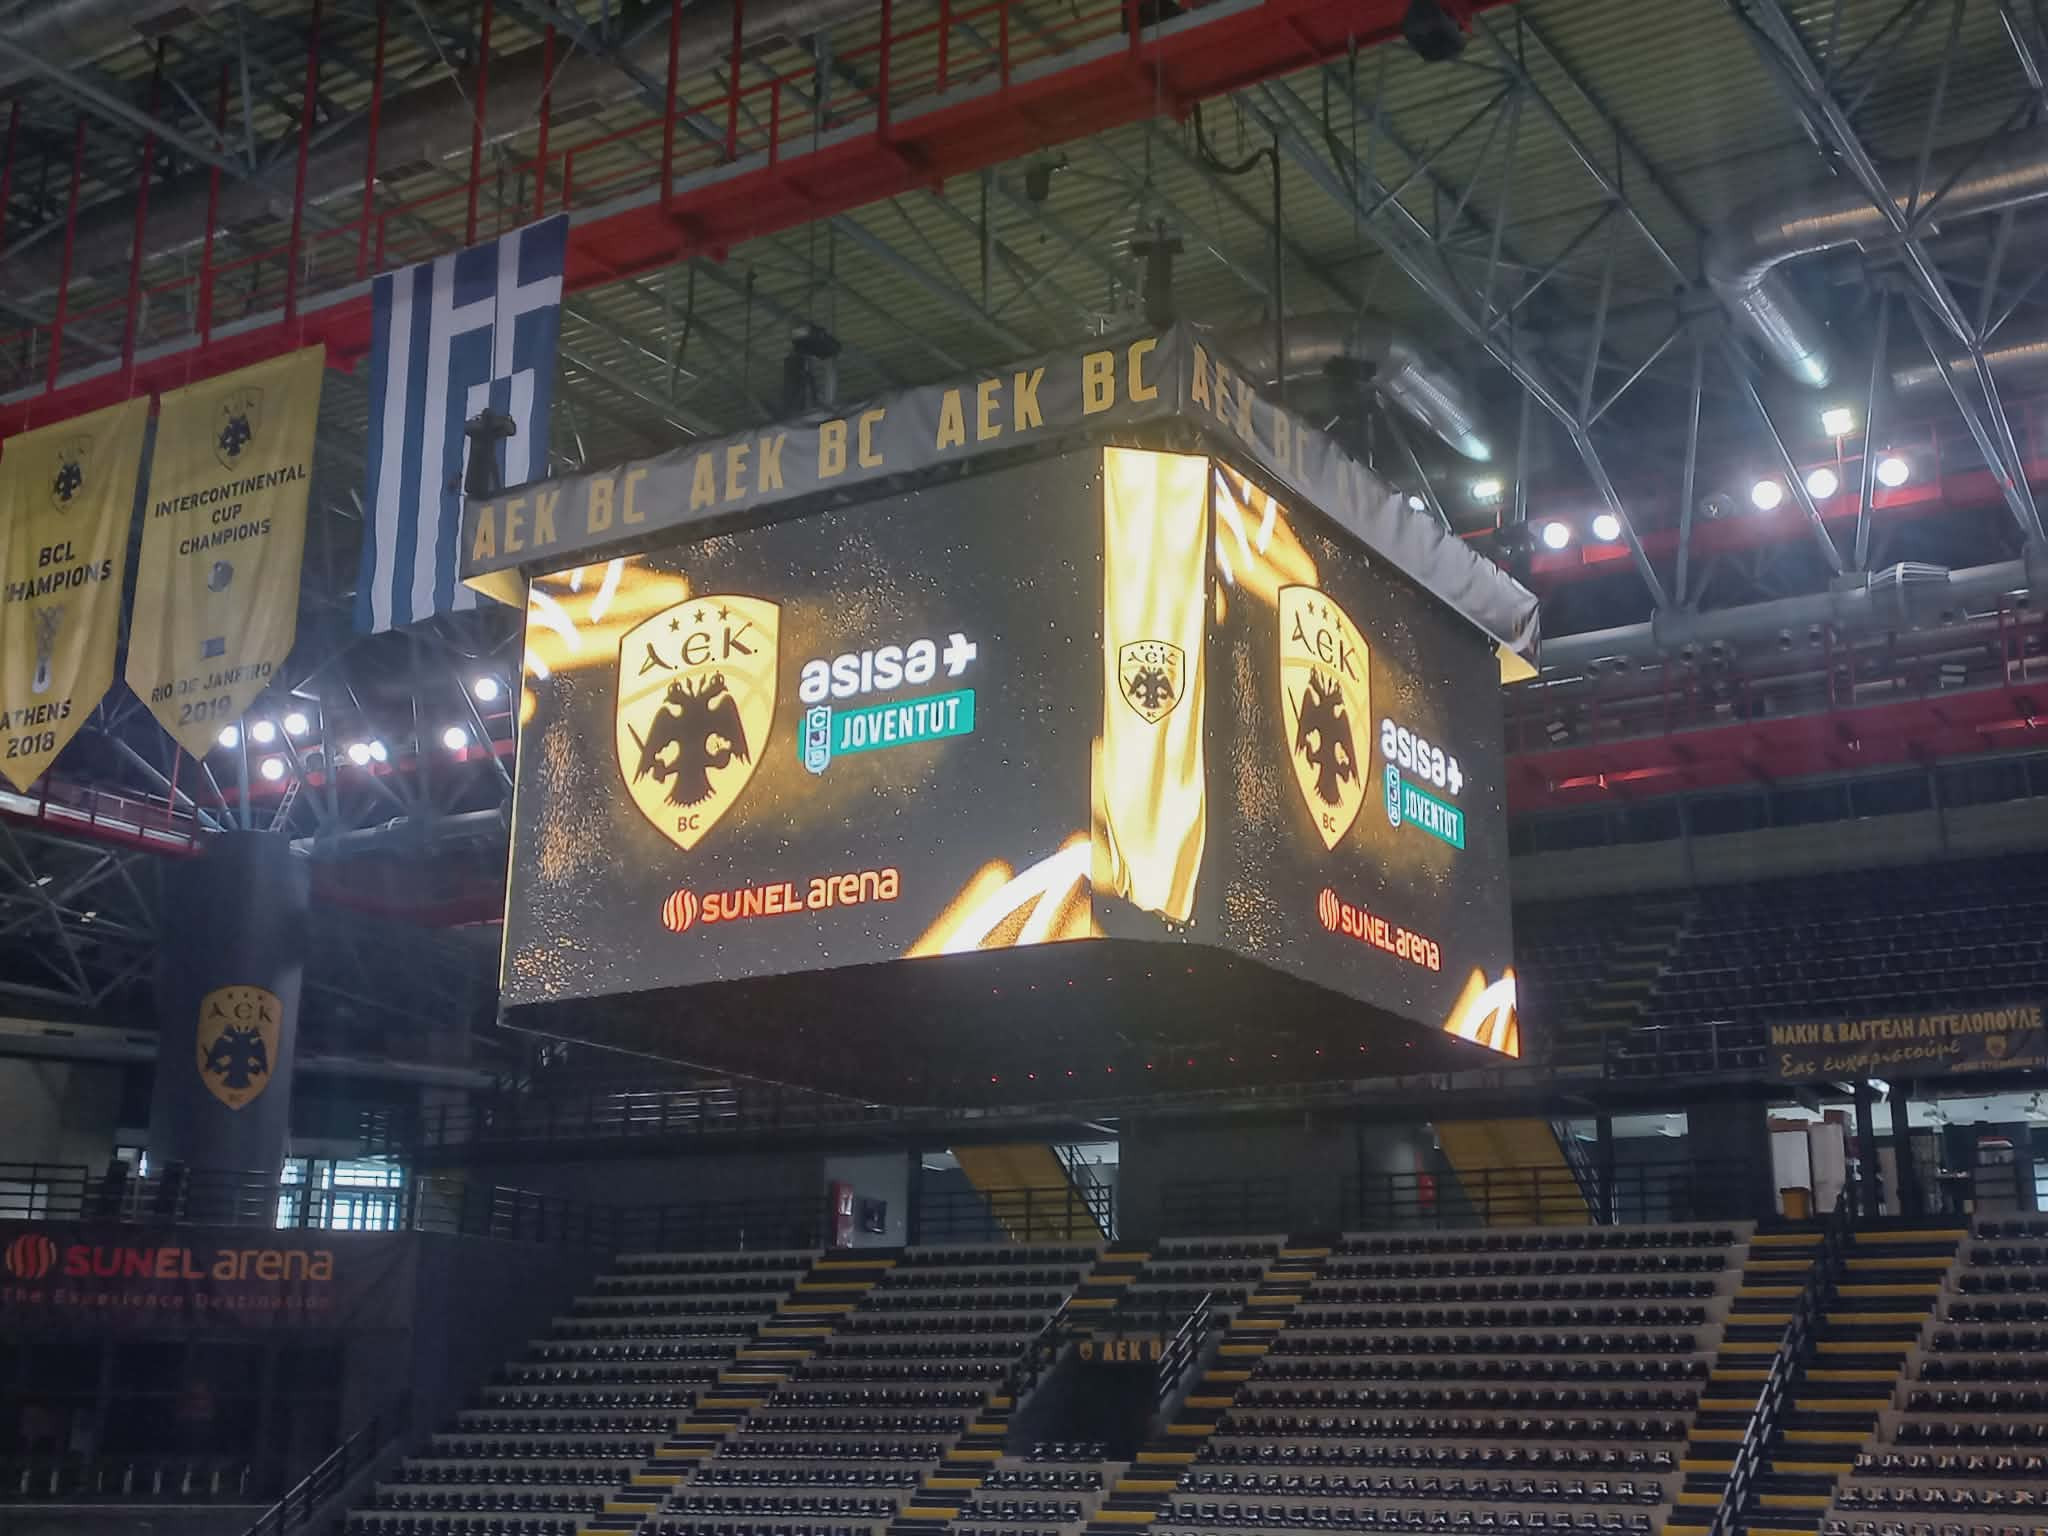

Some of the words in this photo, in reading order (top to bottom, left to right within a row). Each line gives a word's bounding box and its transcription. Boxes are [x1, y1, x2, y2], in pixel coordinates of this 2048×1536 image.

[1191, 342, 1257, 439] AEK
[473, 489, 561, 560] AEK
[587, 469, 647, 534] BC
[690, 432, 787, 511] AEK
[818, 408, 886, 479] BC
[936, 367, 1045, 449] AEK
[1083, 338, 1158, 415] BC
[155, 464, 306, 518] INTERCONTINENTAL
[212, 504, 242, 525] CUP
[39, 541, 76, 568] BCL
[180, 518, 272, 555] CHAMPIONS
[6, 560, 112, 602] HAMPIONS
[151, 683, 174, 703] RIO
[0, 699, 71, 731] ATHENS
[840, 698, 960, 750] JOVENTUT
[7, 732, 55, 758] 2018
[677, 815, 700, 832] BC
[1323, 813, 1336, 833] BC
[1404, 787, 1458, 841] JOVENTUT
[701, 882, 803, 922] SUNEL
[807, 867, 900, 910] arena
[1341, 904, 1396, 952] SUNEL
[1396, 927, 1441, 972] arena
[64, 1247, 205, 1278] SUNEL
[211, 1249, 334, 1281] arena
